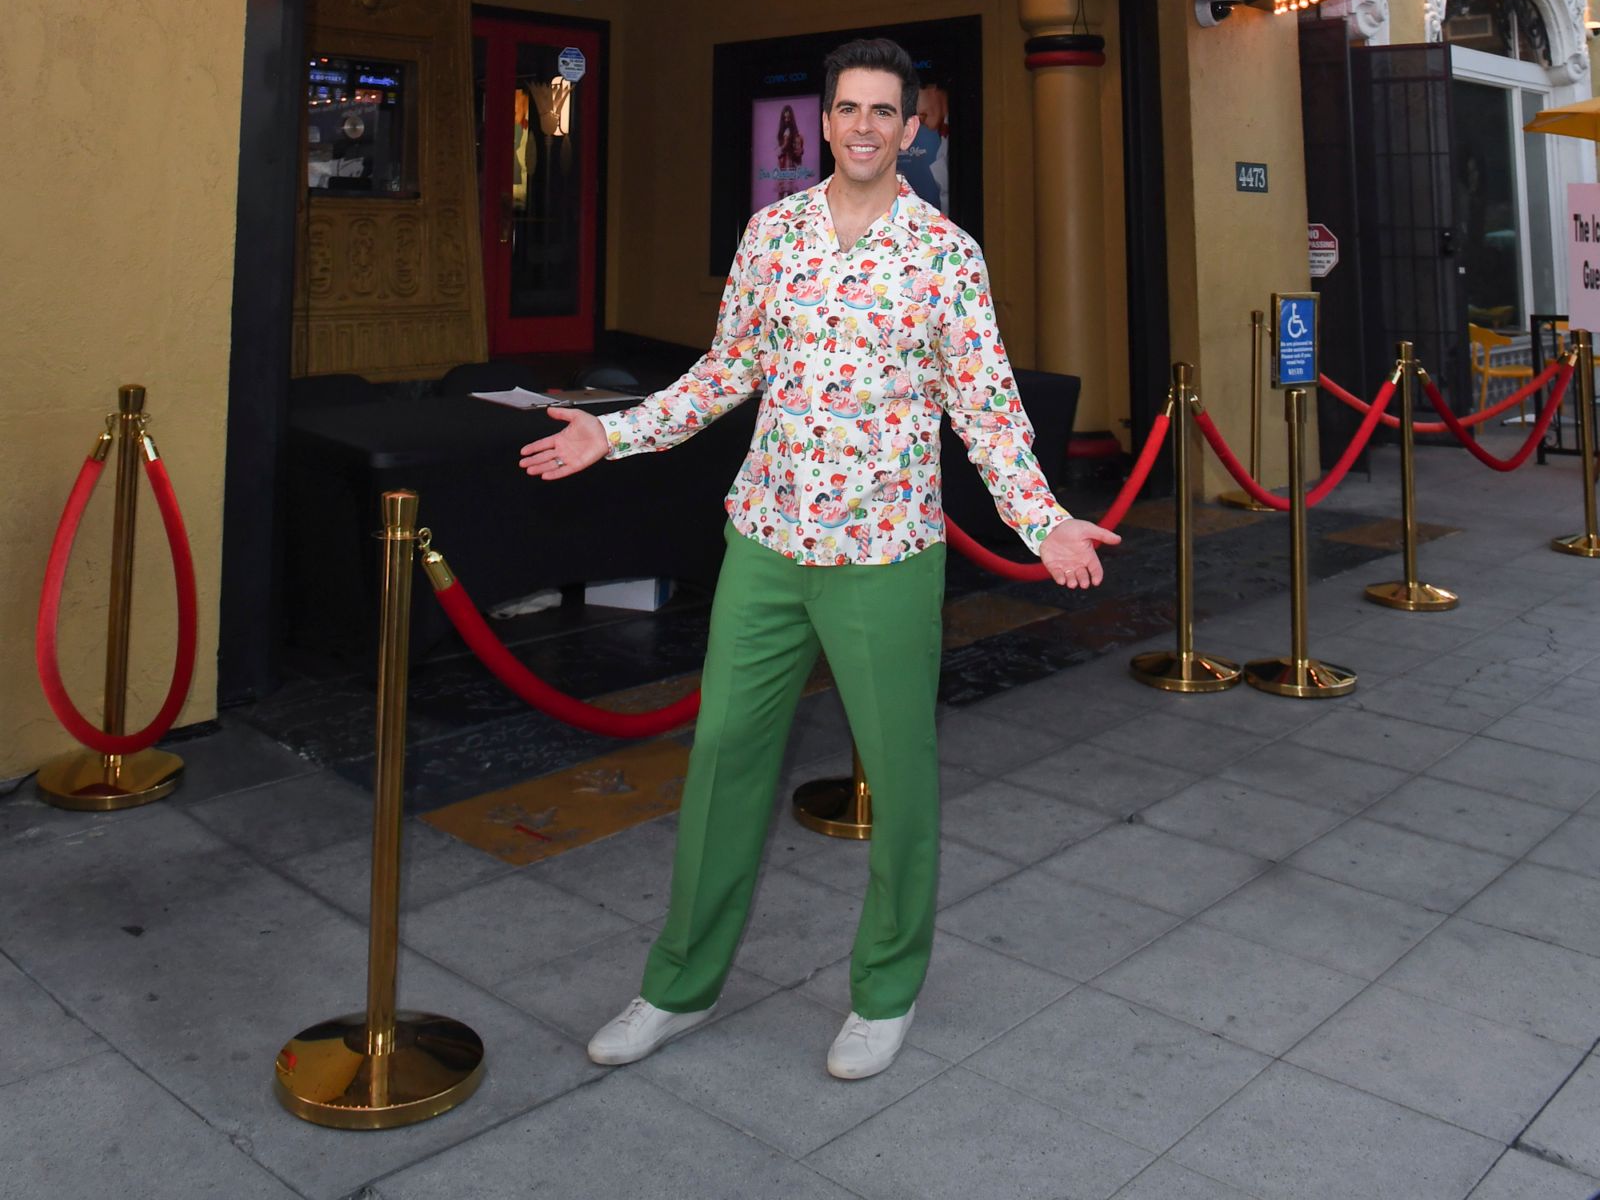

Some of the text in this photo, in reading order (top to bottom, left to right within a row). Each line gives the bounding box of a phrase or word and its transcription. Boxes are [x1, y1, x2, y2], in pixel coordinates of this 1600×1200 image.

[1239, 166, 1266, 188] 4473
[1573, 213, 1600, 242] The Ic
[1583, 260, 1600, 289] Gue
